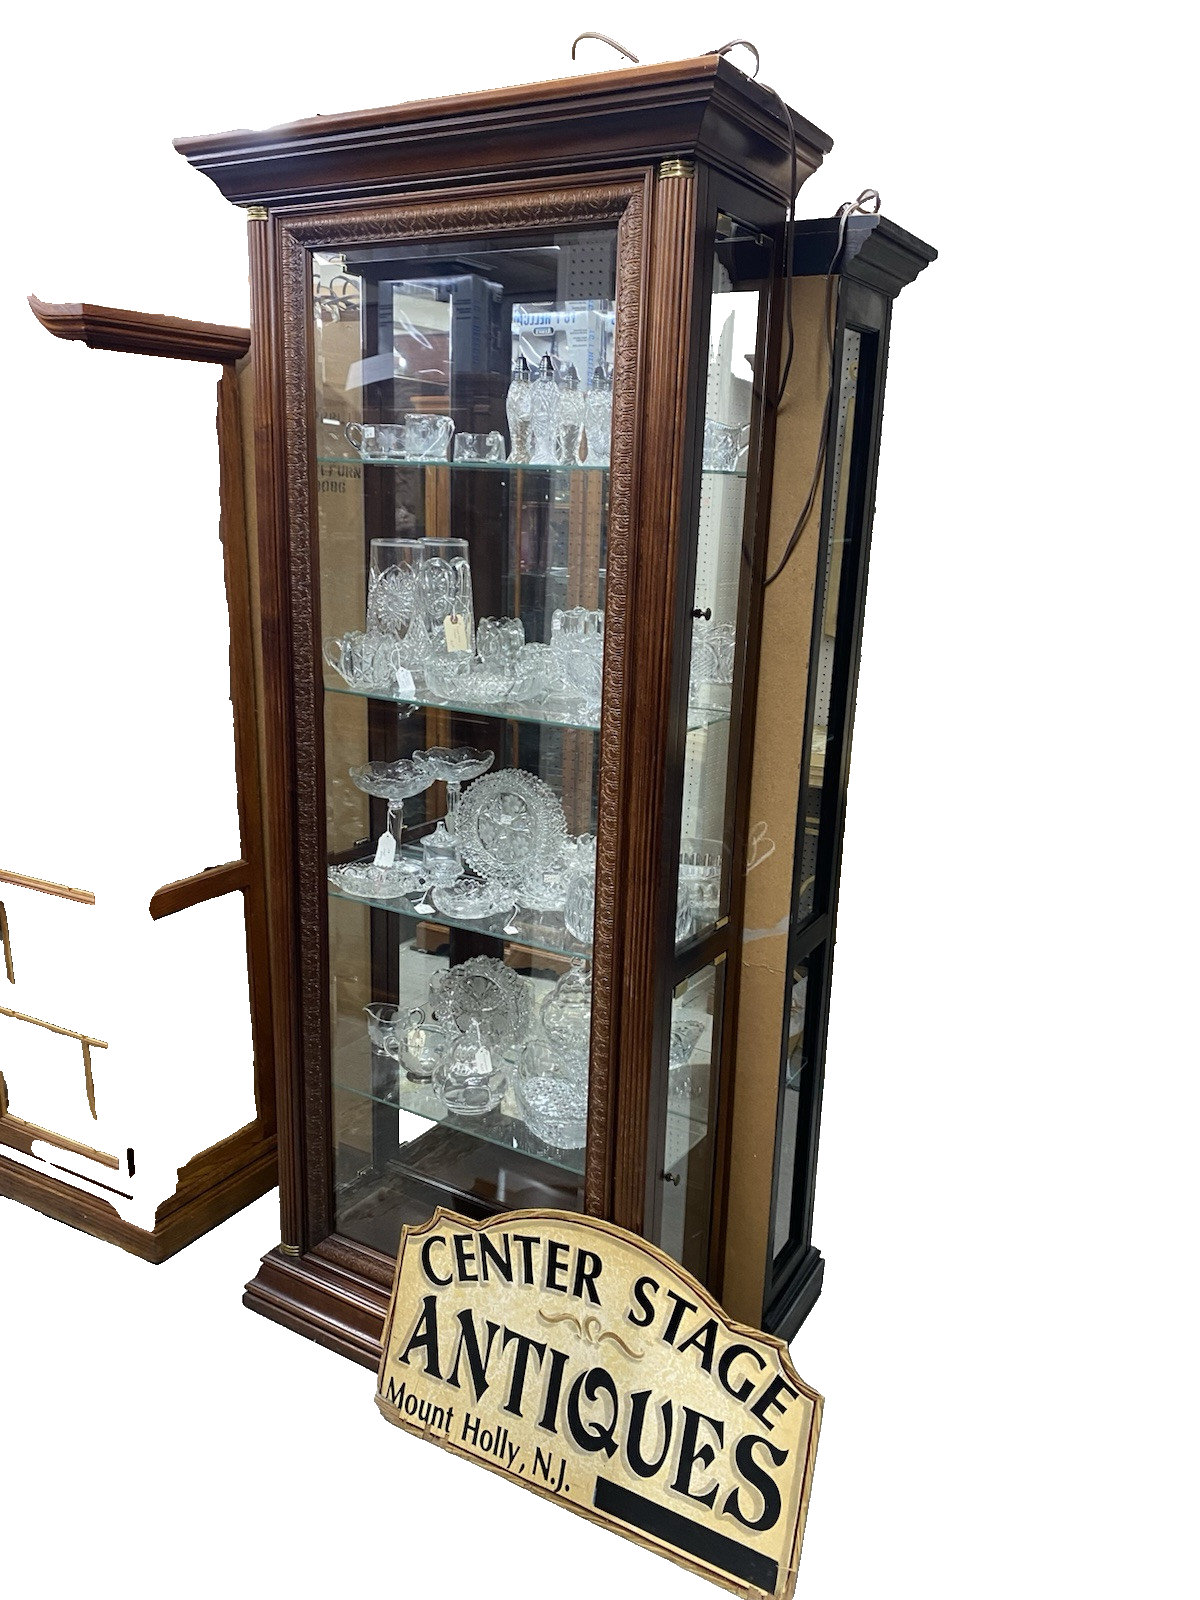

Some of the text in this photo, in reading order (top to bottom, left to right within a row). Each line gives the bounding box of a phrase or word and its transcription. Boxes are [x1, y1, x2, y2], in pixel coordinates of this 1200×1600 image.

[399, 1295, 789, 1532] ANTIQUES
[421, 1233, 799, 1430] CENTER STAGE
[386, 1376, 570, 1493] Mount Holly, N.J.
